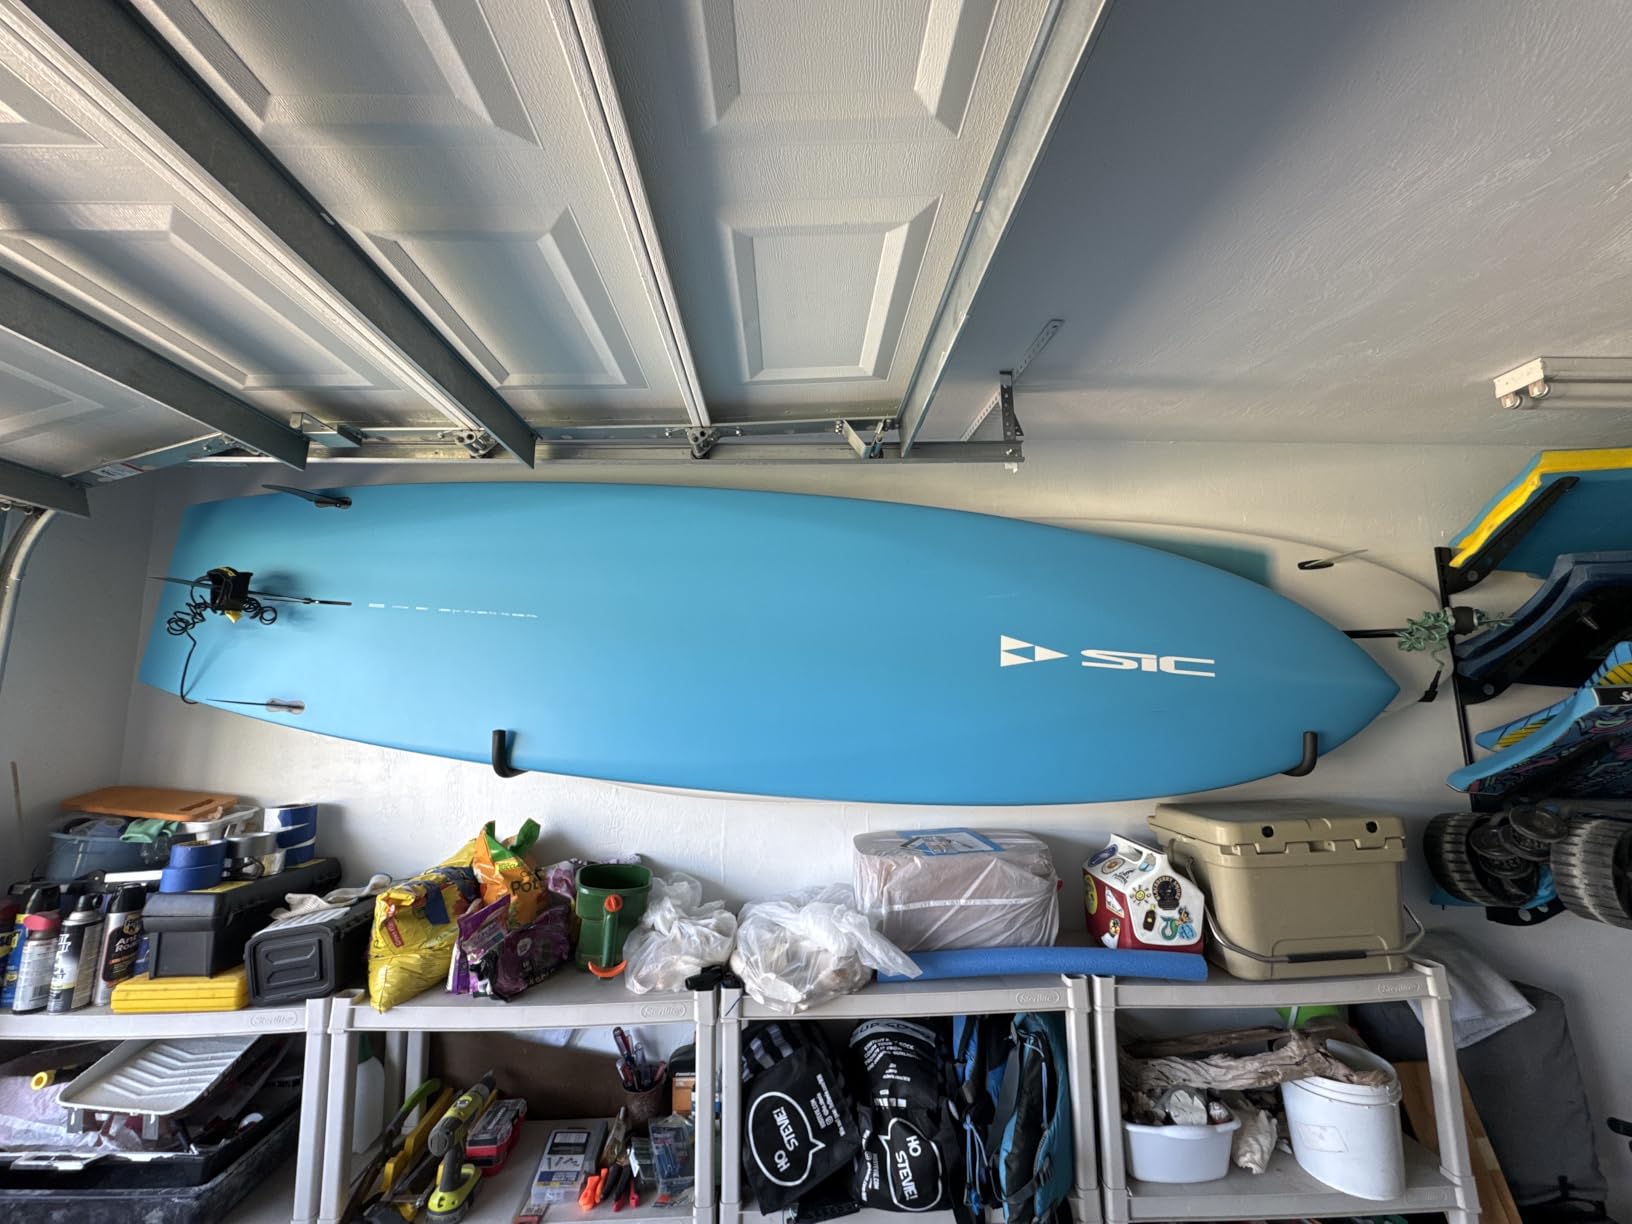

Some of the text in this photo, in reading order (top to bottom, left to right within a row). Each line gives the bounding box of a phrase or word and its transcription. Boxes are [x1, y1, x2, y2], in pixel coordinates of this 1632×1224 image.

[1081, 649, 1216, 678] SIC
[772, 1106, 799, 1152] STEVIE!
[906, 1135, 922, 1157] HO
[774, 1150, 791, 1172] HO
[895, 1150, 919, 1201] STEVIE!
